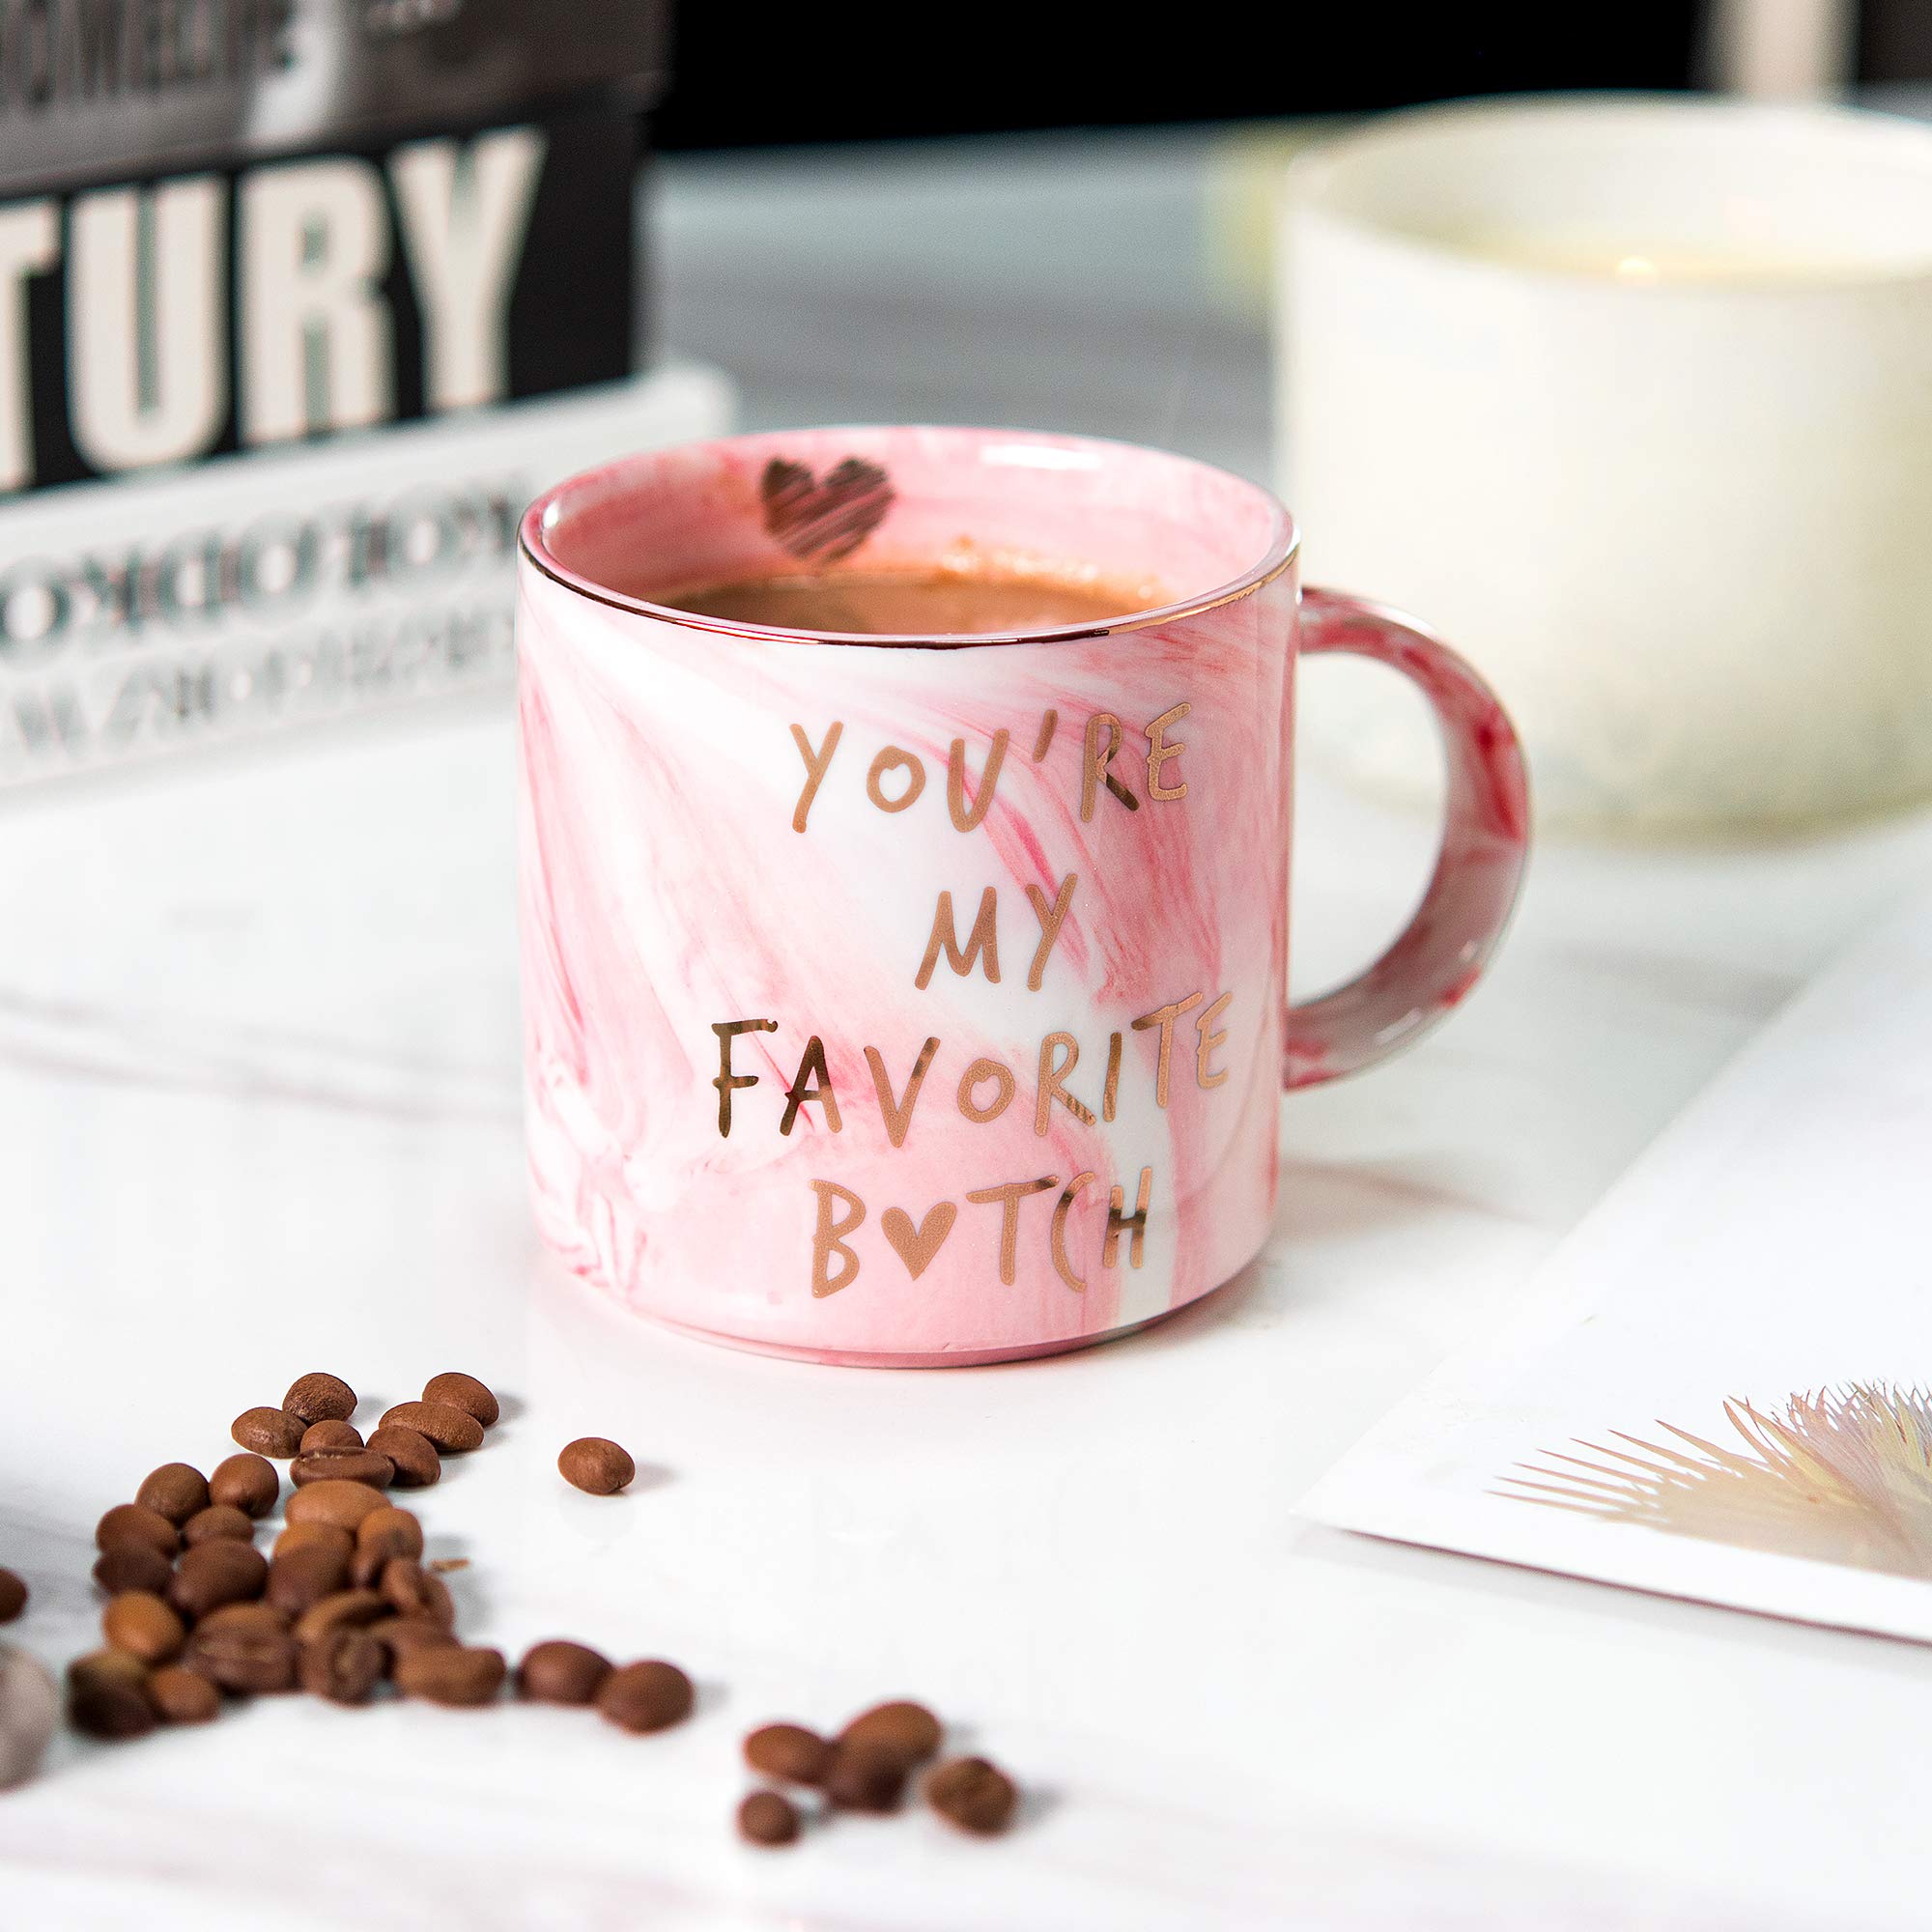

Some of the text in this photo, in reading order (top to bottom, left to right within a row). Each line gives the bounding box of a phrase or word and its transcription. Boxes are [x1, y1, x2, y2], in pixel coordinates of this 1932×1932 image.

[789, 702, 1191, 833] YOU'RE
[915, 873, 1078, 991] MY
[711, 991, 1234, 1149] FAVORITE
